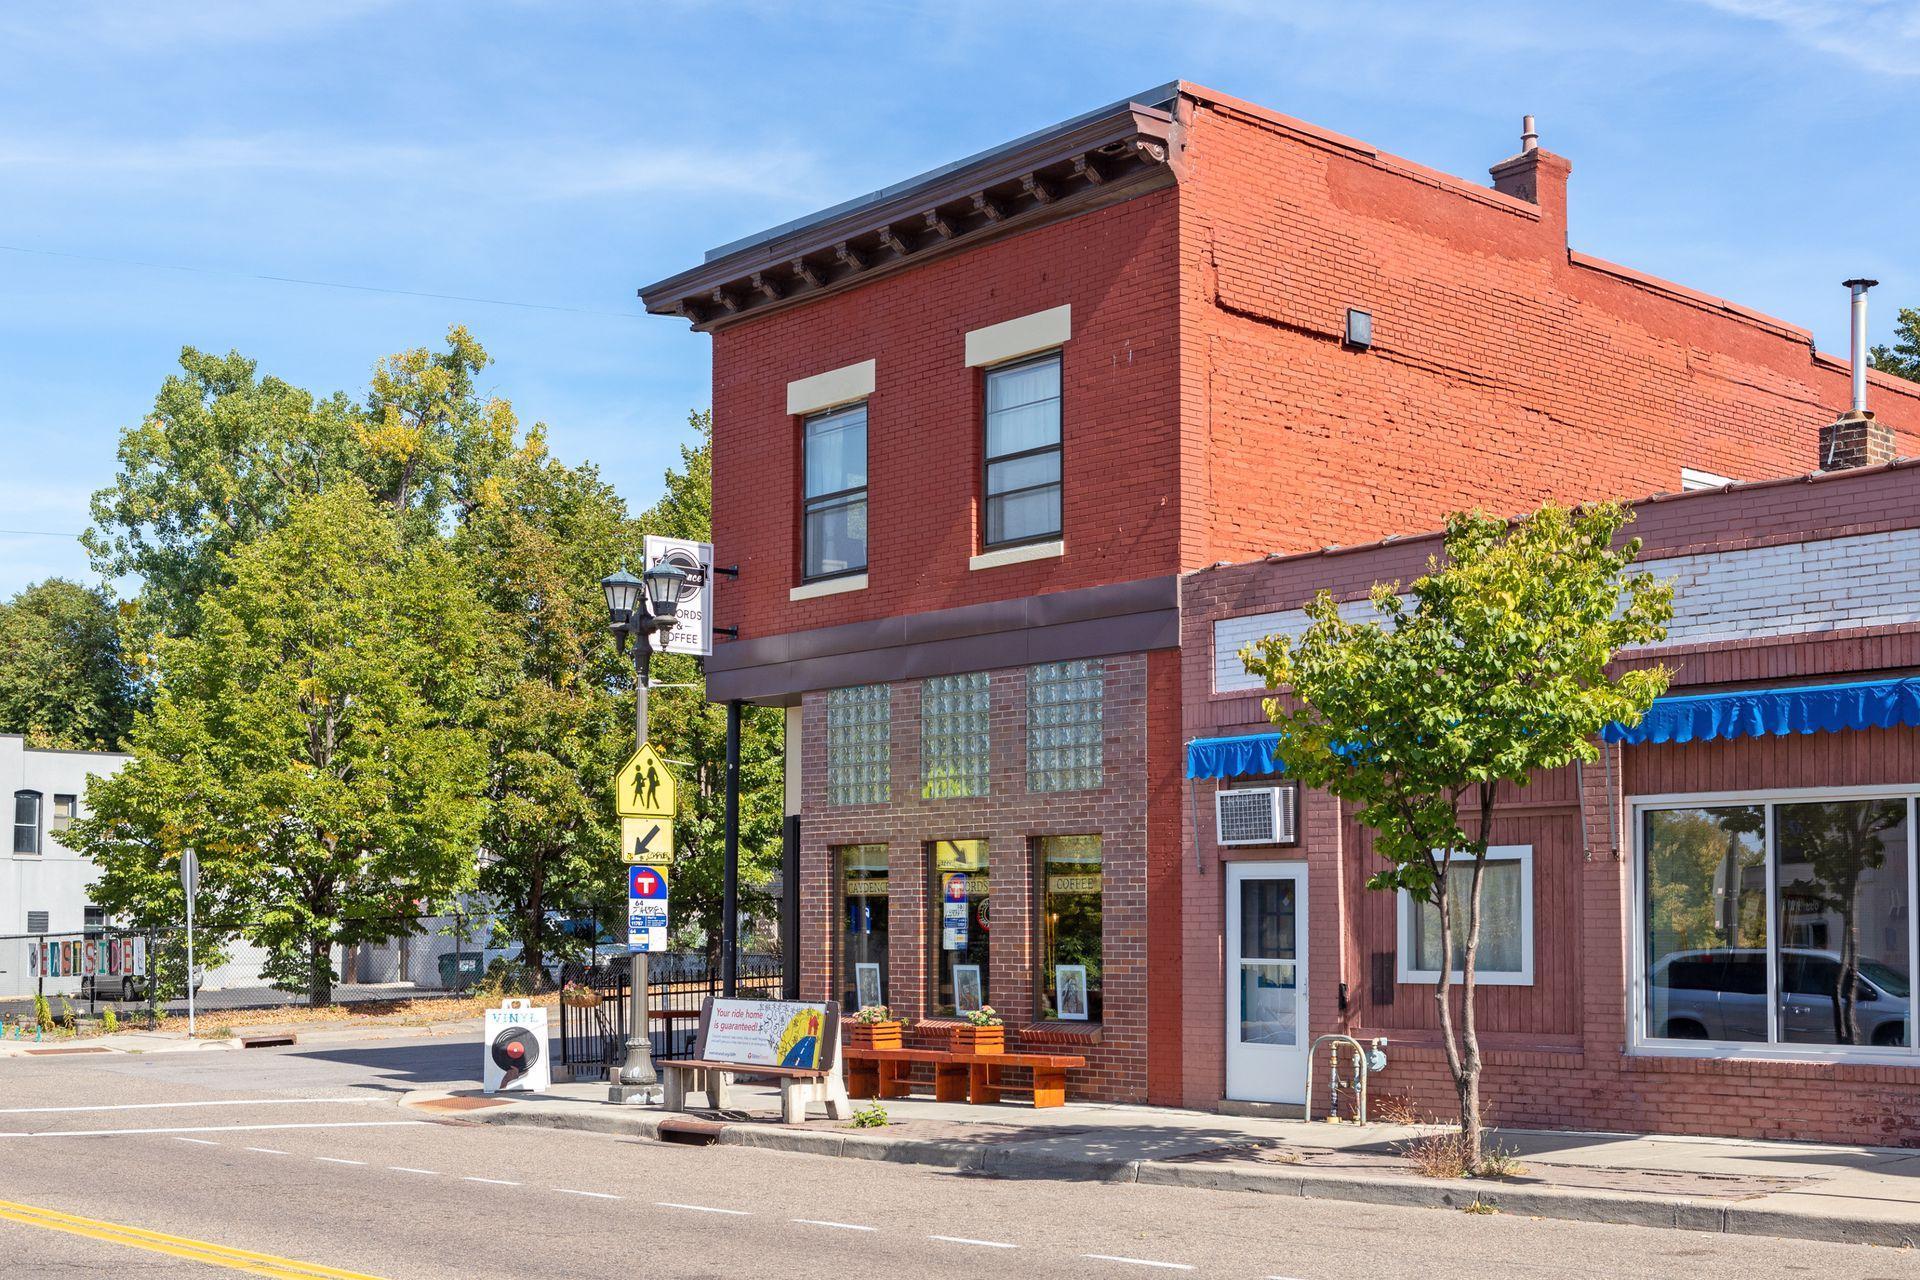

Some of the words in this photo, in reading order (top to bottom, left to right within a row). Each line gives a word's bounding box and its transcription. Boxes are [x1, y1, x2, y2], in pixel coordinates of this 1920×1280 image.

[676, 608, 702, 620] ORDS
[668, 633, 698, 645] OFFEE
[637, 877, 655, 894] T
[1056, 878, 1094, 890] COFFEE
[493, 1013, 537, 1023] VINYL
[716, 1008, 730, 1017] Your
[731, 1009, 744, 1018] ride
[745, 1010, 763, 1019] home
[713, 1020, 719, 1029] is
[720, 1022, 758, 1031] guaranteed!
